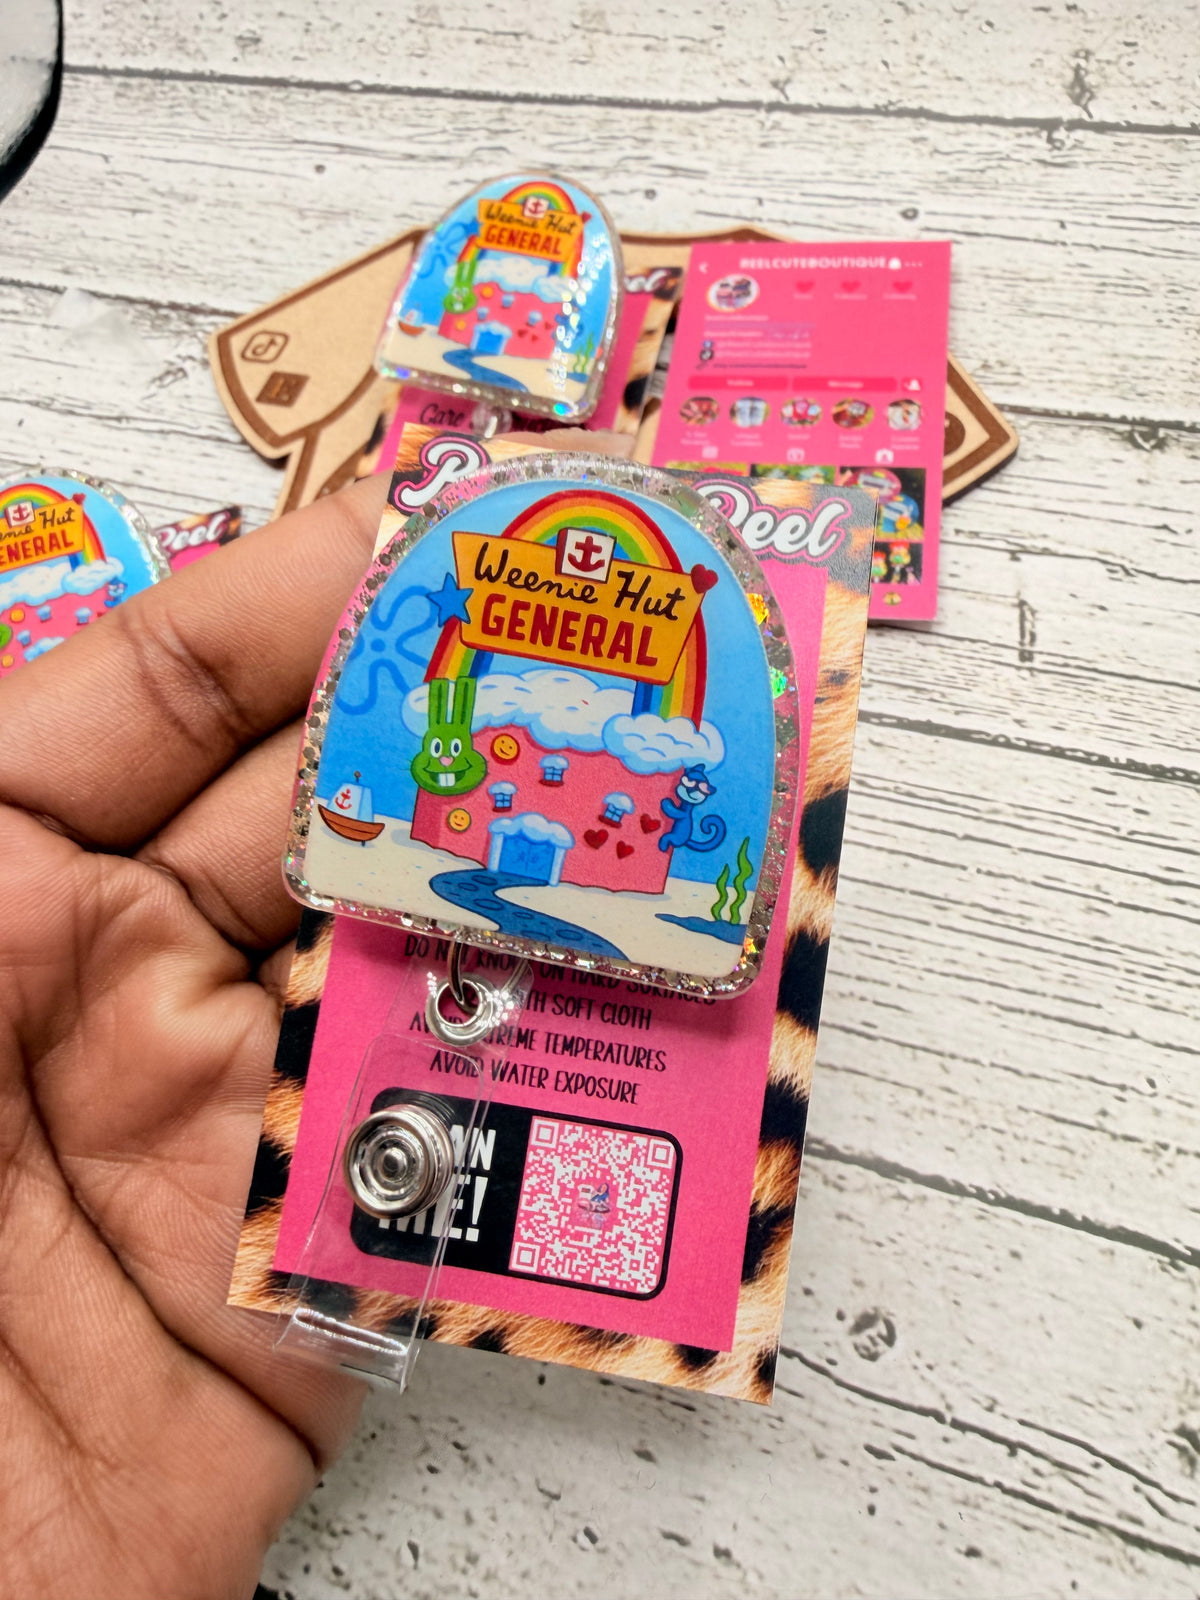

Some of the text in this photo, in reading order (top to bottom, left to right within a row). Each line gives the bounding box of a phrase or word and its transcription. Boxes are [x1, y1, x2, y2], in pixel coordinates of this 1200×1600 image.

[485, 223, 563, 255] GENERAL
[546, 213, 578, 235] Hut
[39, 506, 75, 529] Hut
[474, 541, 687, 622] Weenie Hut
[480, 592, 659, 668] GENERAL
[404, 934, 431, 959] DO
[434, 939, 475, 968] NT
[539, 958, 565, 981] ON
[551, 993, 594, 1020] SOFT
[600, 1001, 653, 1031] CLOTH
[544, 1031, 668, 1072] TEMPERATURES
[429, 1050, 643, 1105] AVOID WATER EXPOSURE
